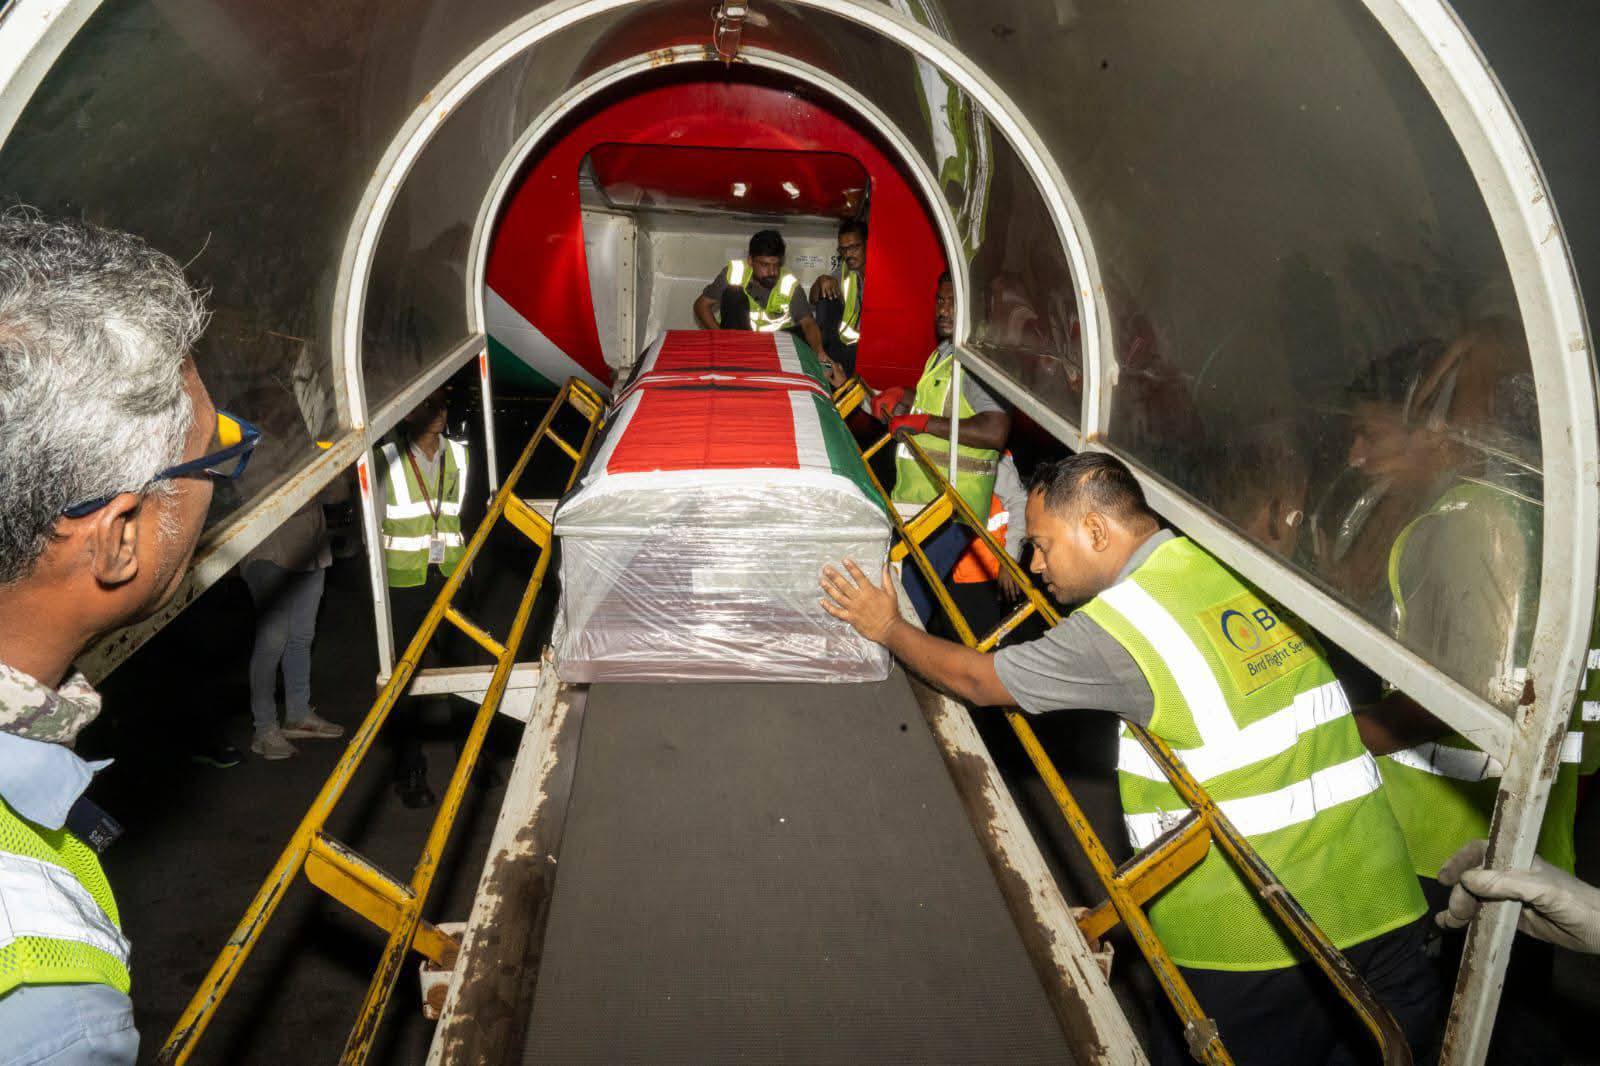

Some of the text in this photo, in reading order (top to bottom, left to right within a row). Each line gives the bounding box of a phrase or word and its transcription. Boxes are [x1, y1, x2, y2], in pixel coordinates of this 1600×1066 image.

[1252, 606, 1279, 631] B
[1247, 658, 1267, 676] Bird
[1266, 648, 1291, 666] Flight
